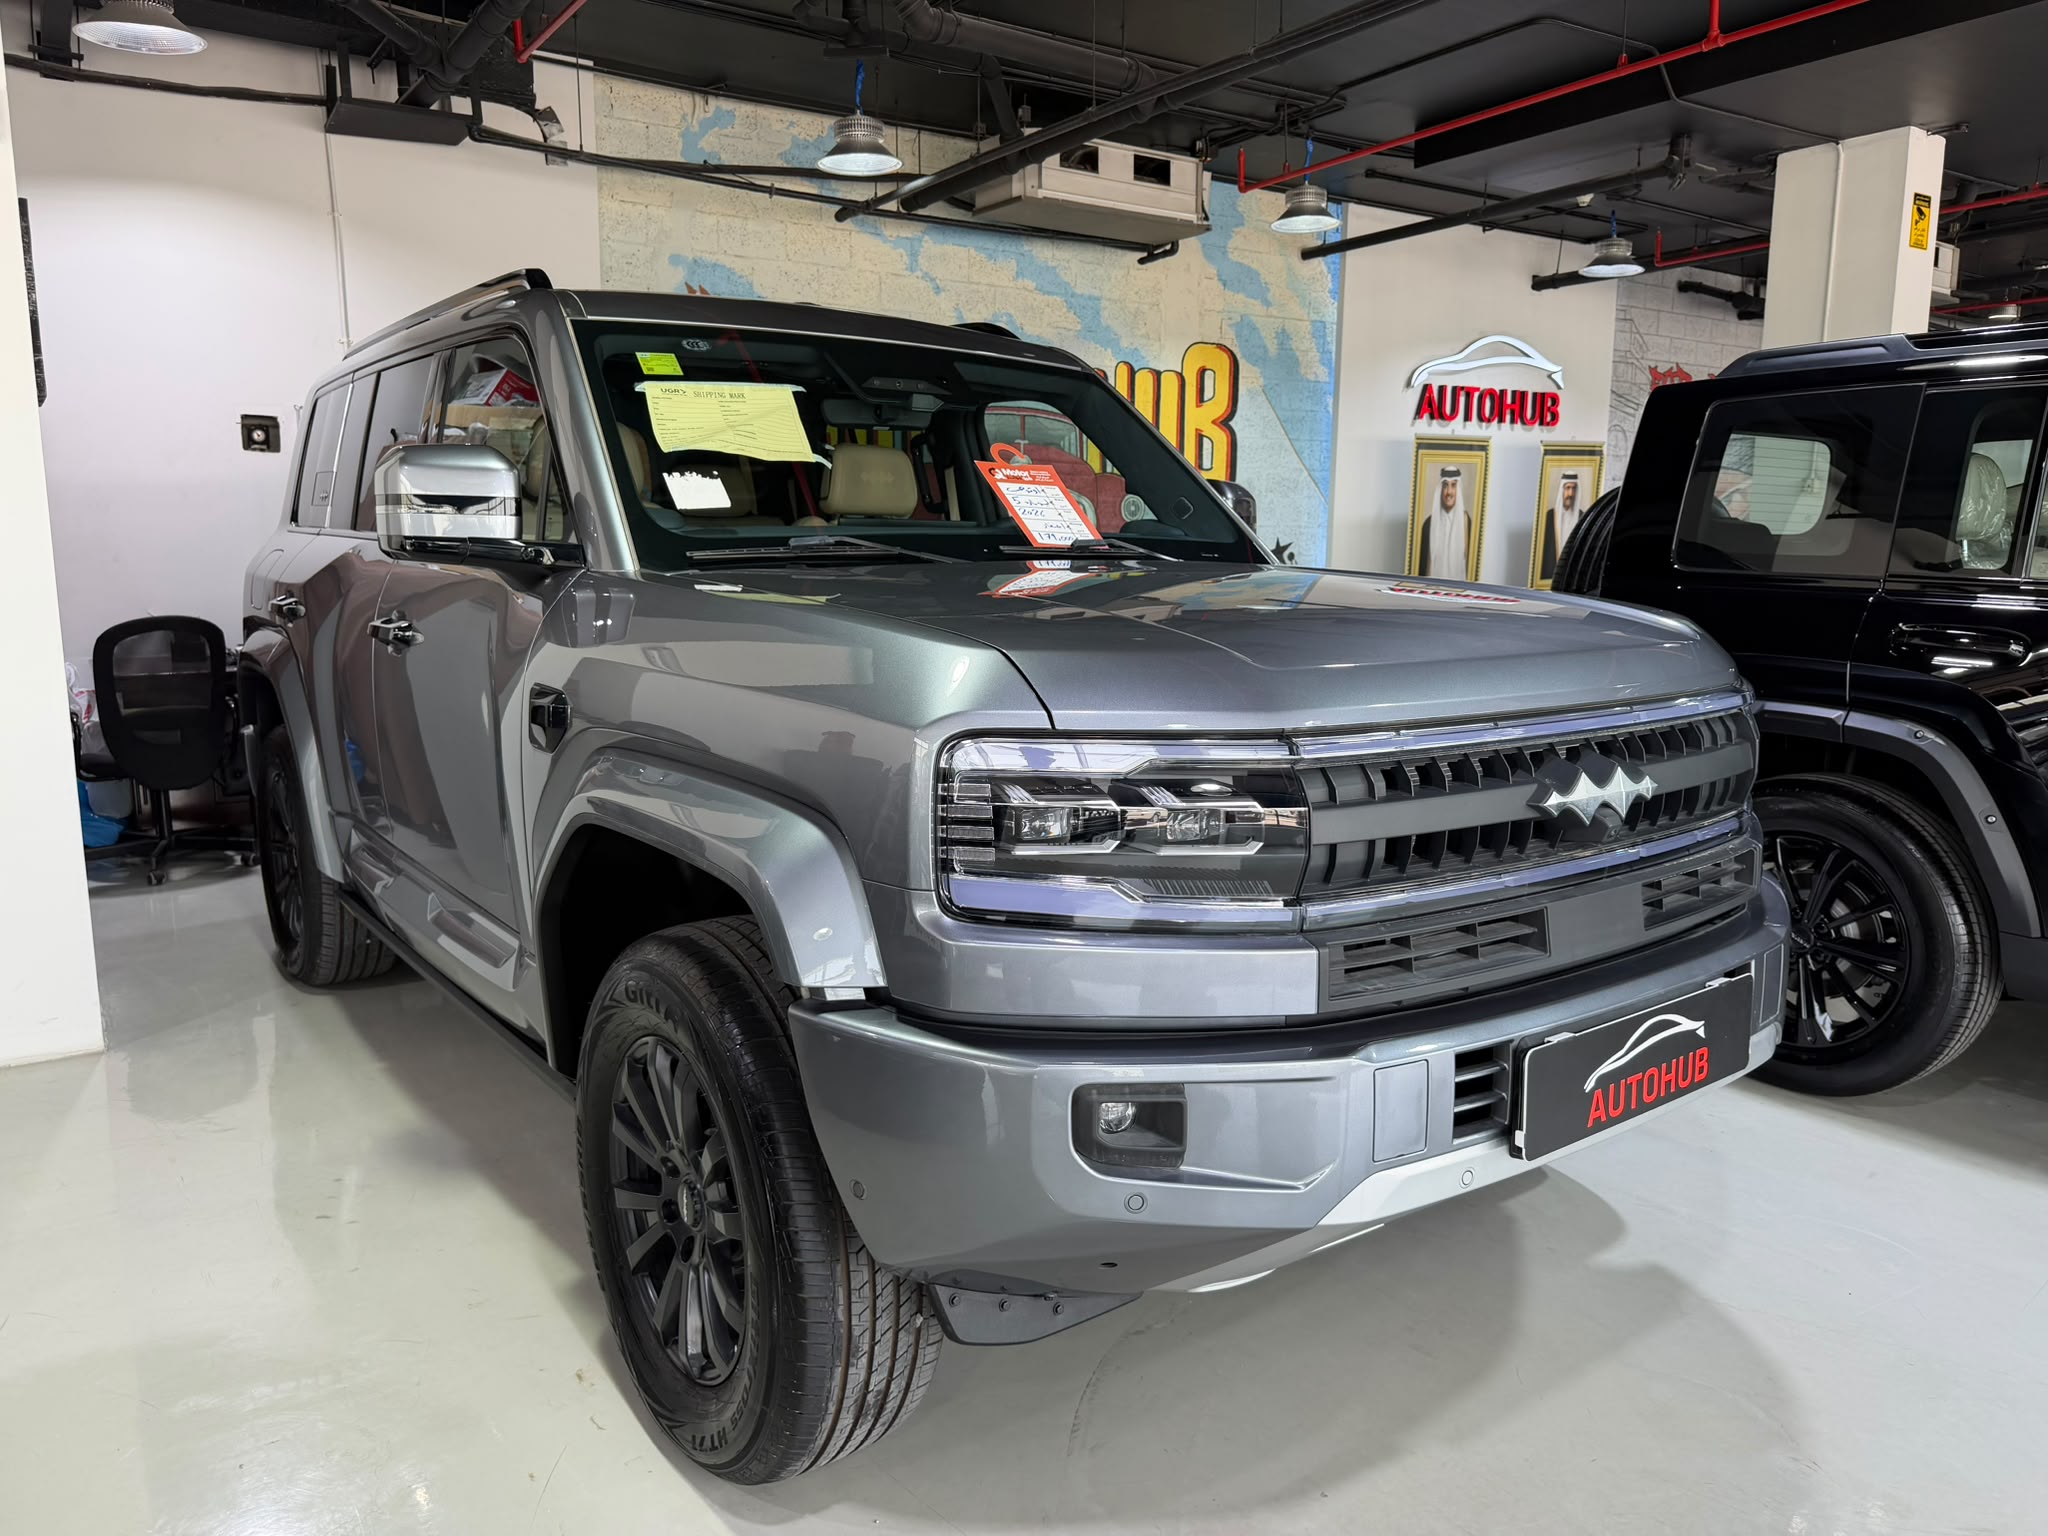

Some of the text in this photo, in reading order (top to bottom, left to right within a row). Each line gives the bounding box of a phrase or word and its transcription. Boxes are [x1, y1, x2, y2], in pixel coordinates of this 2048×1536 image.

[693, 391, 726, 399] SHIPPING
[1415, 383, 1561, 427] AUTOHUB
[1587, 1046, 1710, 1128] AUTOHUB
